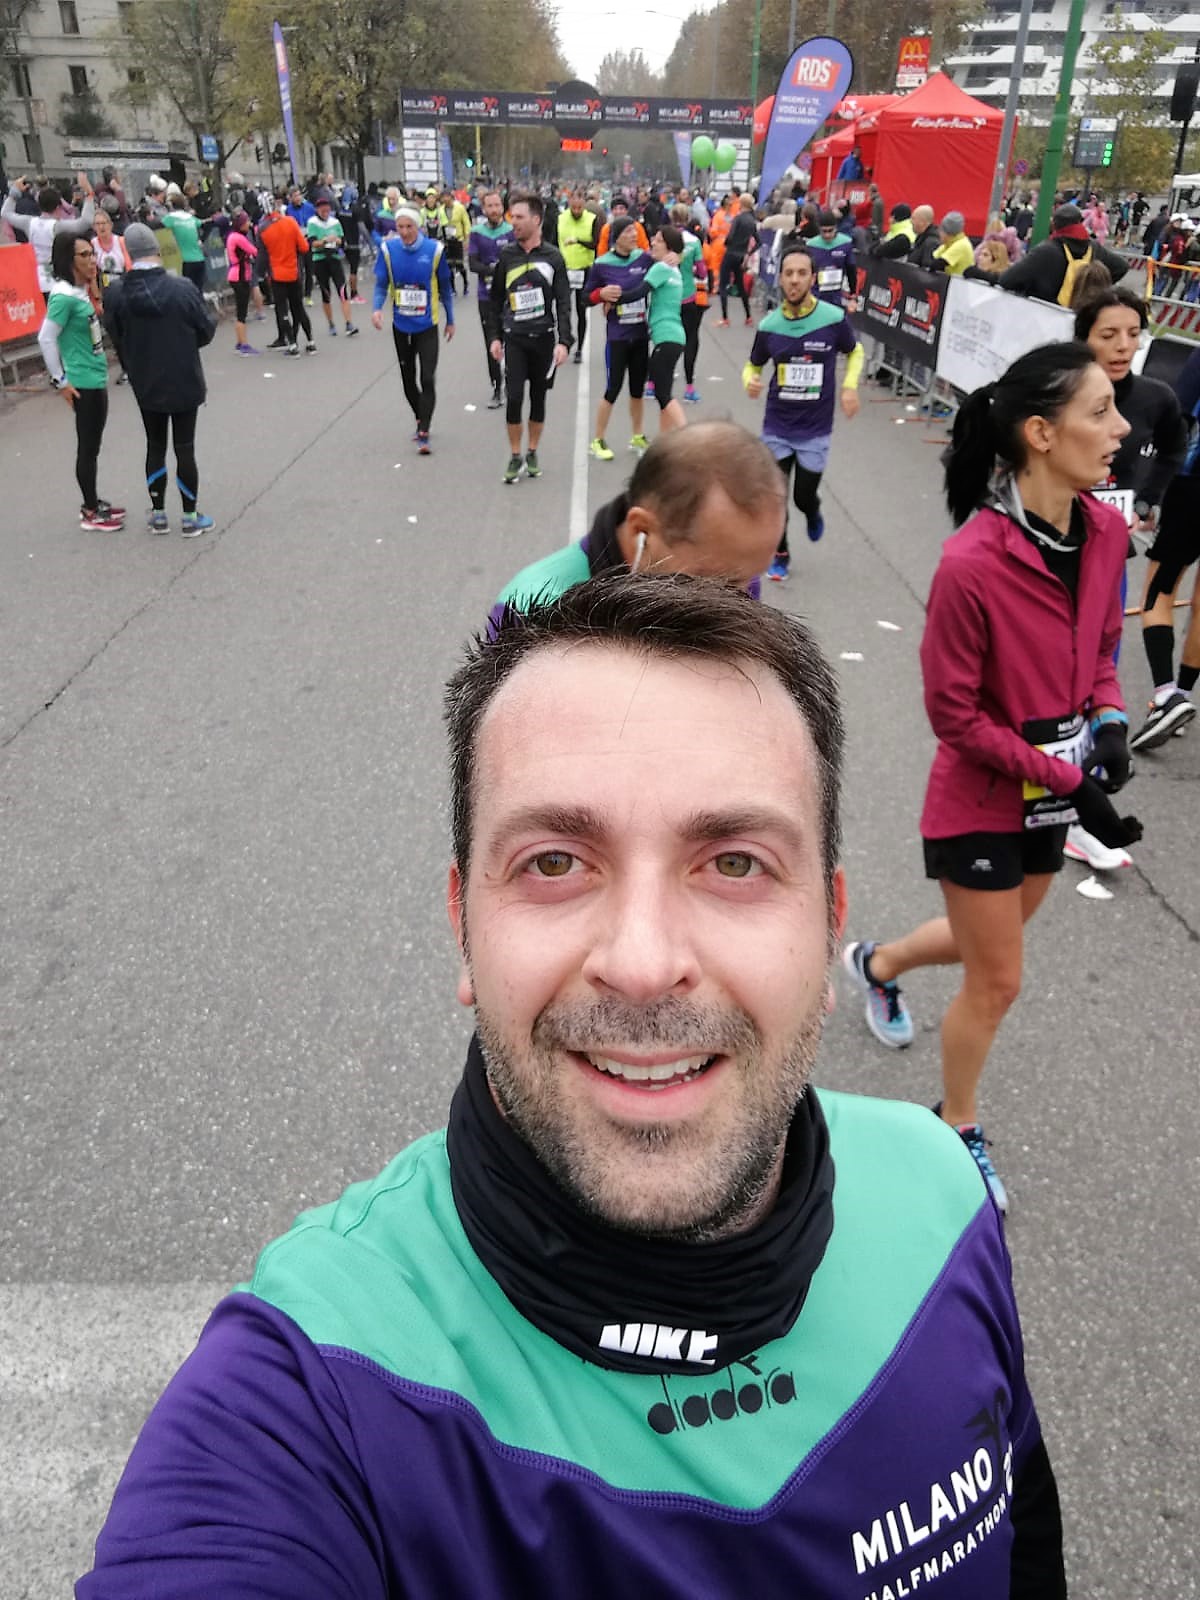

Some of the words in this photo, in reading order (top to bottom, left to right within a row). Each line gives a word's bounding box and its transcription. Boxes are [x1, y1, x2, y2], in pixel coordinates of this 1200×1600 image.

[797, 58, 832, 84] RDS
[403, 99, 436, 109] MILANO
[508, 103, 540, 112] MILANO
[555, 103, 588, 113] MILANO
[599, 1323, 718, 1365] NIKE
[647, 1366, 797, 1435] diadora
[852, 1447, 993, 1575] MILANO
